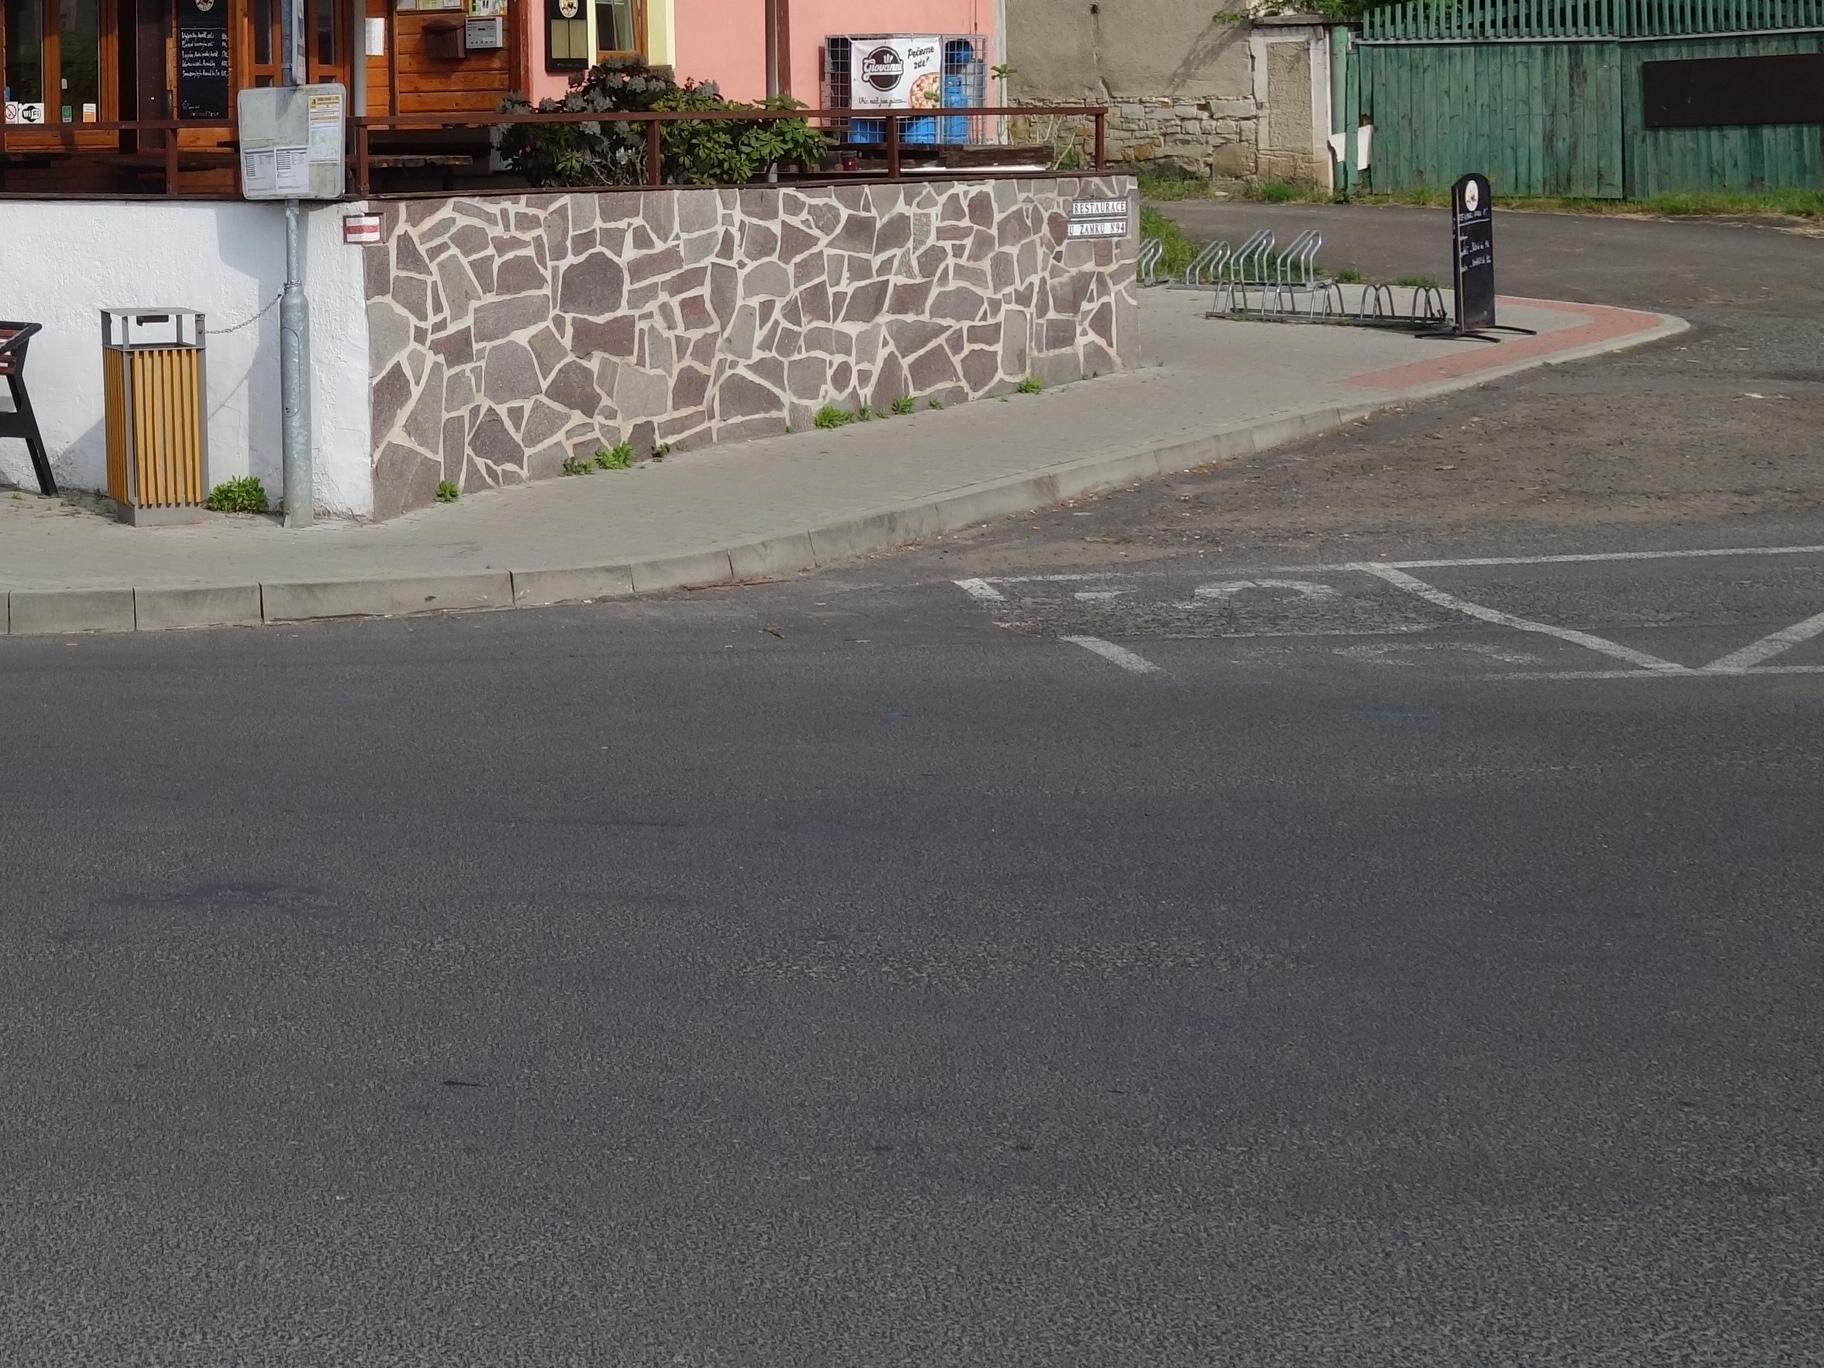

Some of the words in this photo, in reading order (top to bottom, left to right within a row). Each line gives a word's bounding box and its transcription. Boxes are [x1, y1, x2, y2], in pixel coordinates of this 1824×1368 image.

[907, 45, 935, 59] Pečeme
[863, 59, 903, 73] Giovanni
[1074, 202, 1126, 214] RESTAURACE
